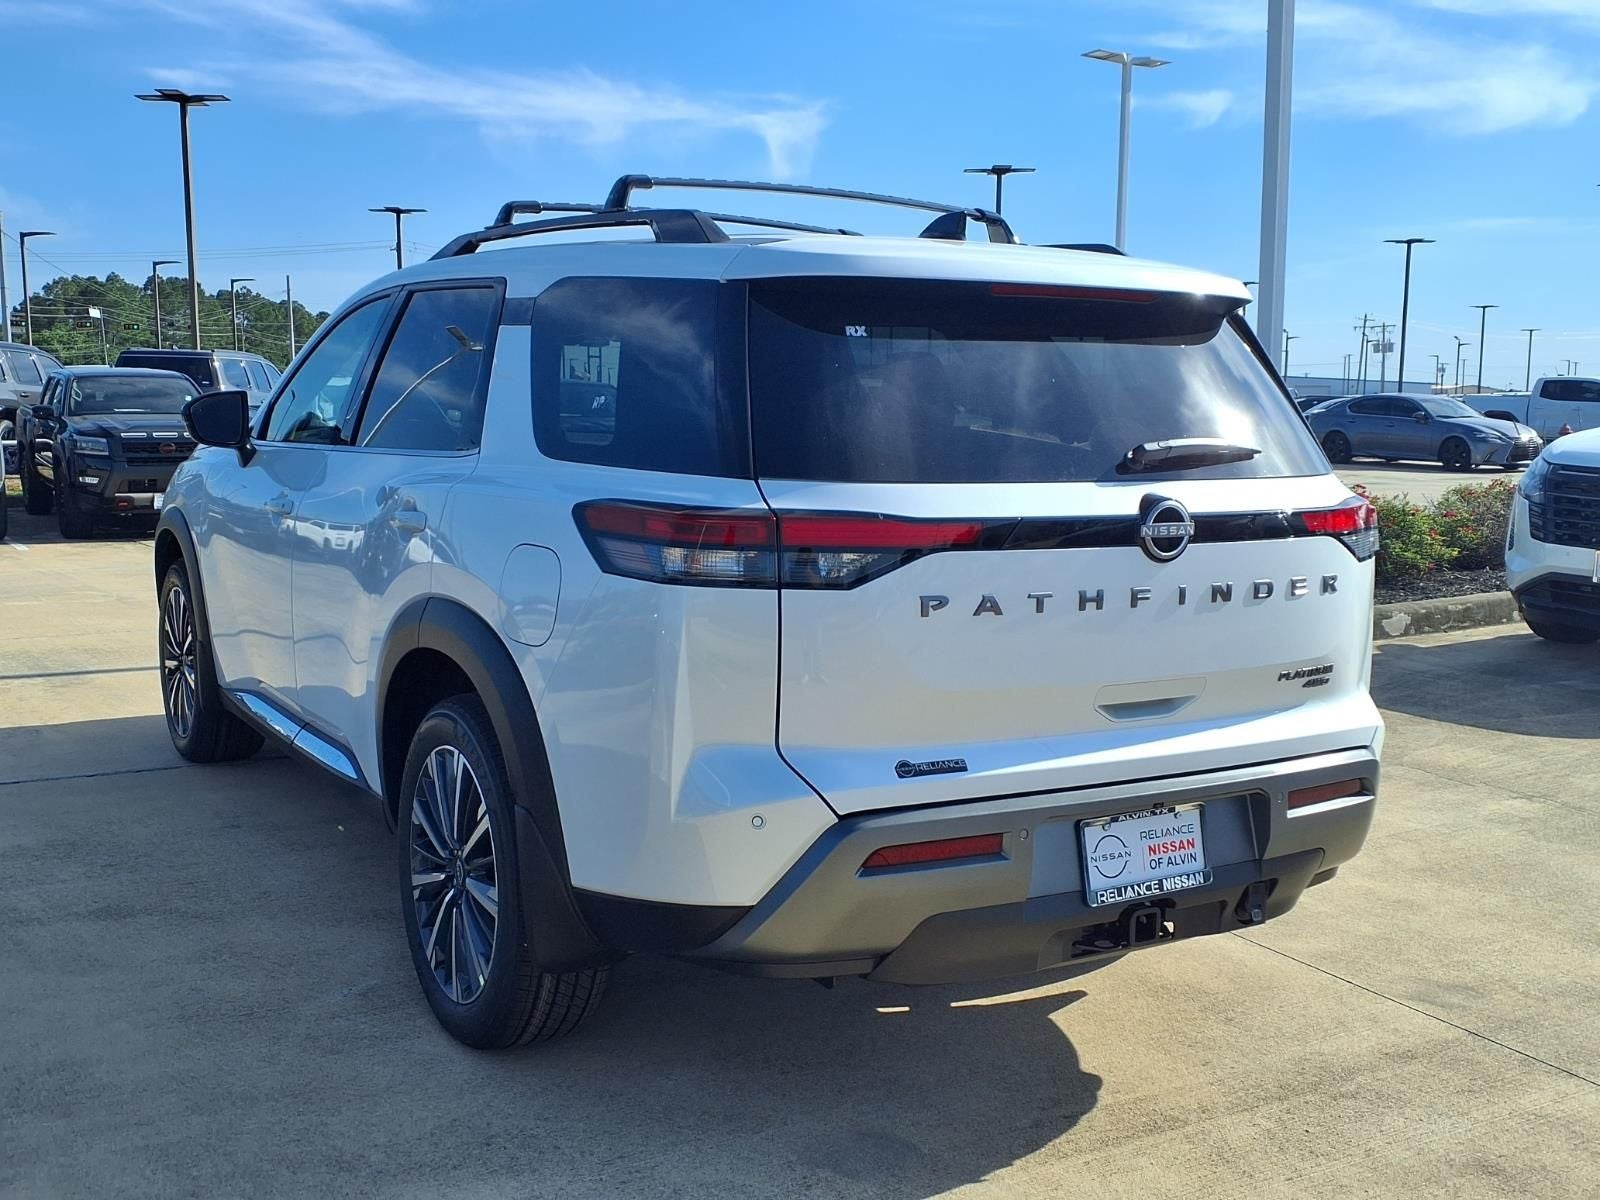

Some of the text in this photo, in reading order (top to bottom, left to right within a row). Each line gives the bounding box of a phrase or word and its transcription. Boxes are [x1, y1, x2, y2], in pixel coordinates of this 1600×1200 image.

[1142, 525, 1194, 536] NISSAN
[919, 573, 1340, 618] PATHFINDER
[914, 759, 966, 772] RELIANCE
[1139, 823, 1195, 841] RELIANCE
[1148, 838, 1195, 857] NISSAN
[1090, 850, 1132, 864] NISSAN
[1149, 852, 1197, 870] OF ALVIN
[1097, 872, 1204, 904] RELIANCE NISSAN
